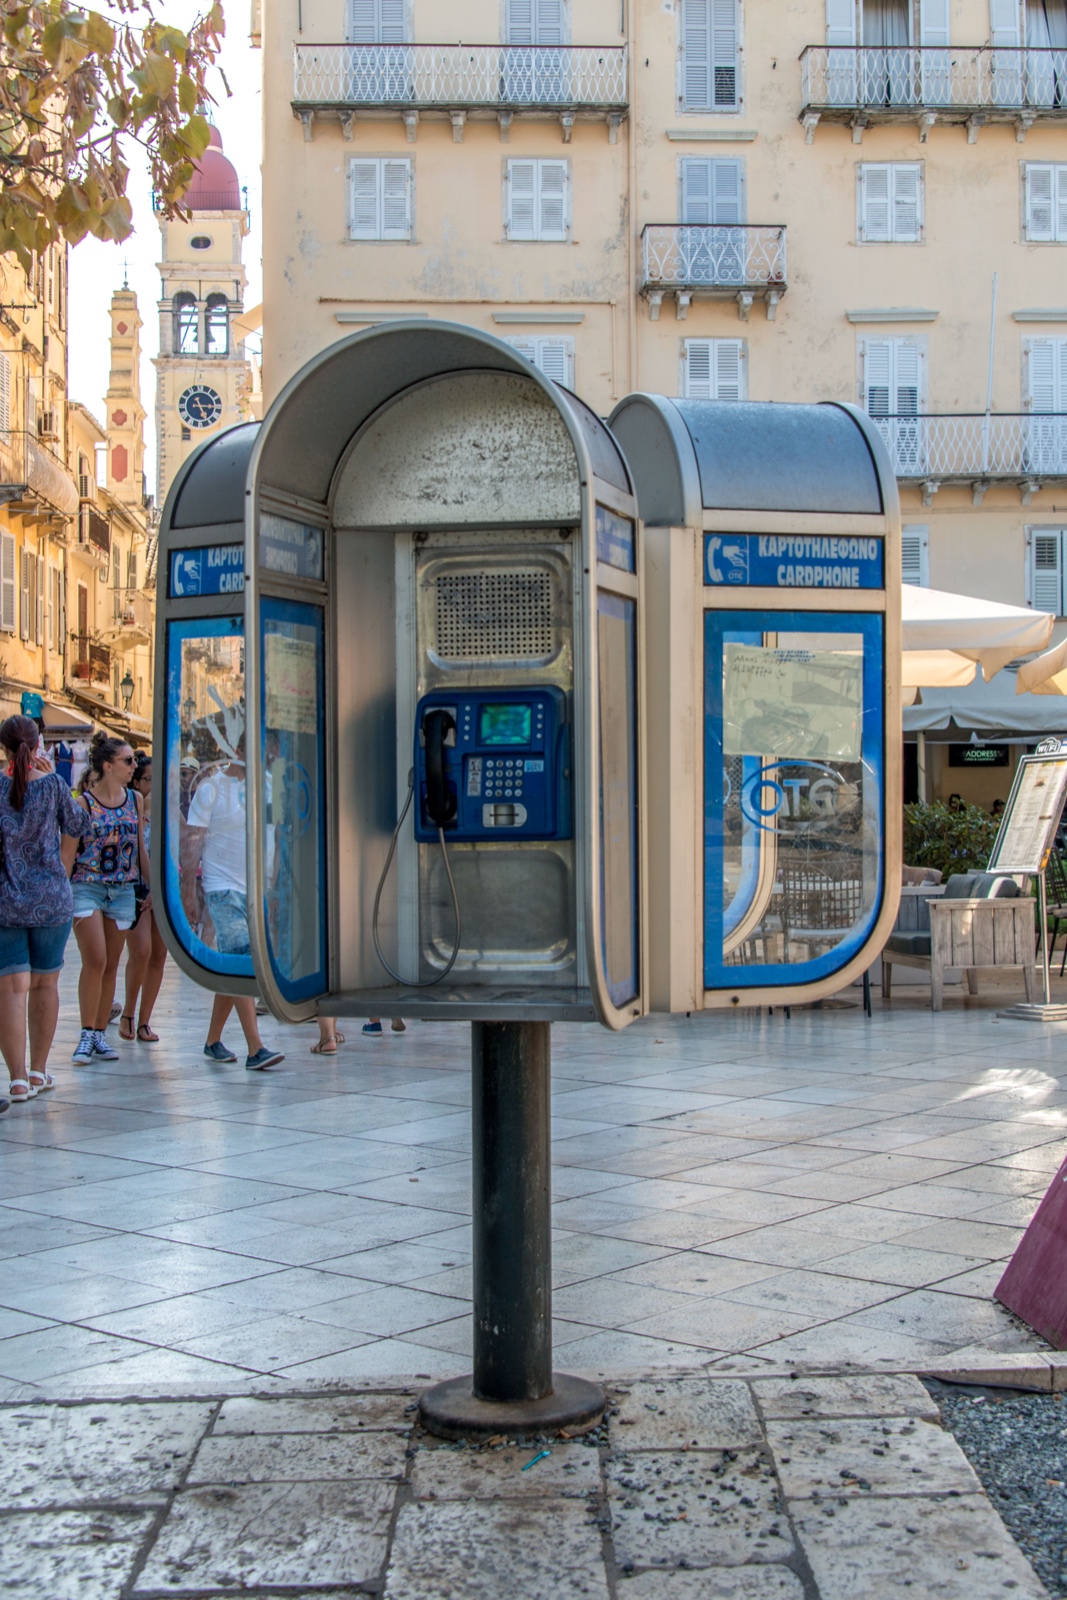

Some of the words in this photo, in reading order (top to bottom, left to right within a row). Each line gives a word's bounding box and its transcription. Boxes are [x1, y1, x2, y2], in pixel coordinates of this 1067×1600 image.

[758, 535, 878, 561] ΚΑΡΤΟΤΗΛΕΦΩΝΟ
[777, 564, 860, 588] CARDPHONE
[965, 749, 997, 758] ADDRESS
